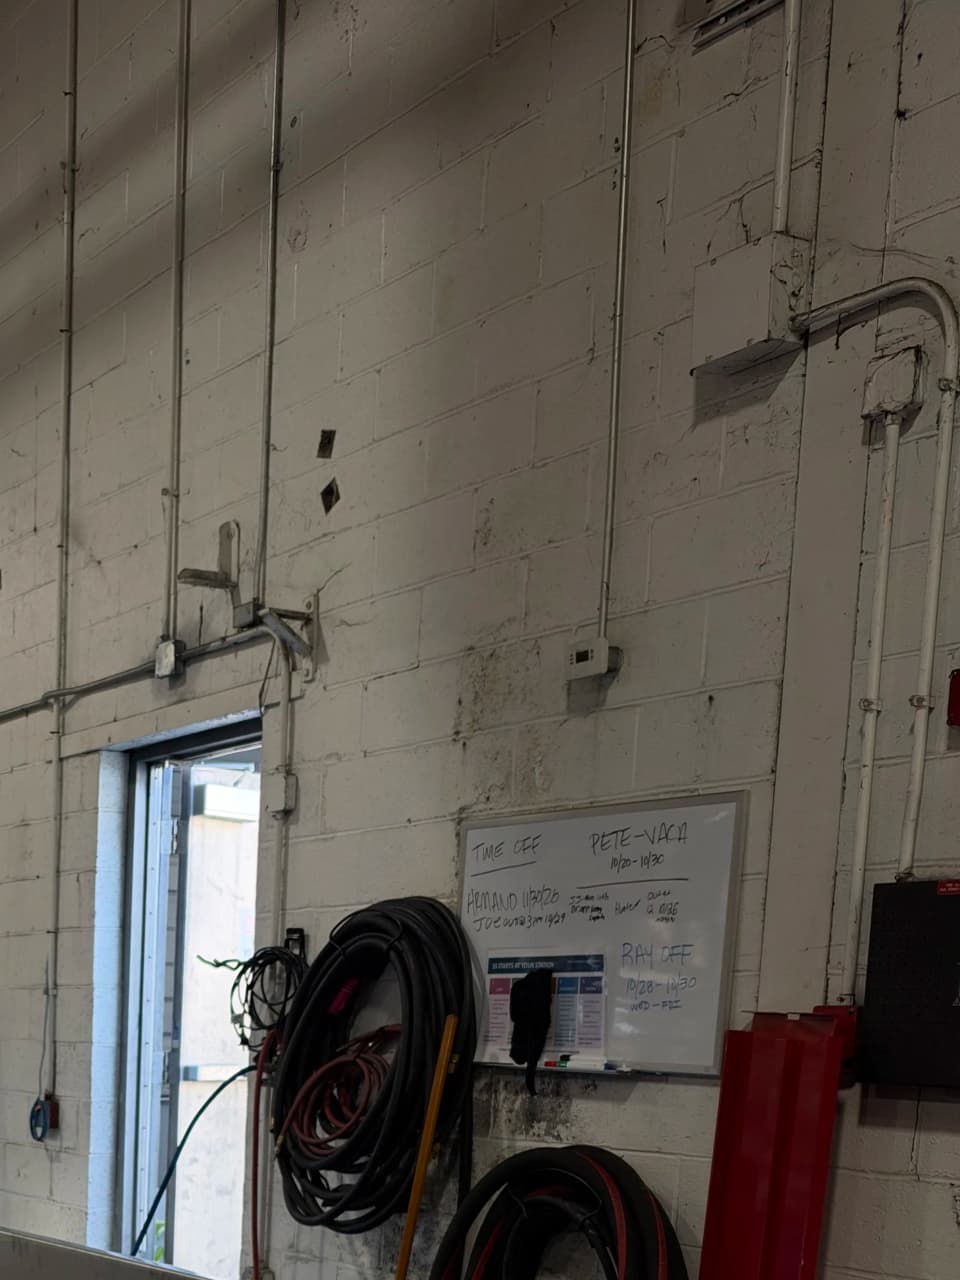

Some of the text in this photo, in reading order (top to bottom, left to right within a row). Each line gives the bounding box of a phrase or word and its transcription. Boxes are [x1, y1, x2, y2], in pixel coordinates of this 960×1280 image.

[472, 834, 542, 863] TIME OFF
[622, 942, 654, 969] RAY
[662, 943, 695, 967] OFF
